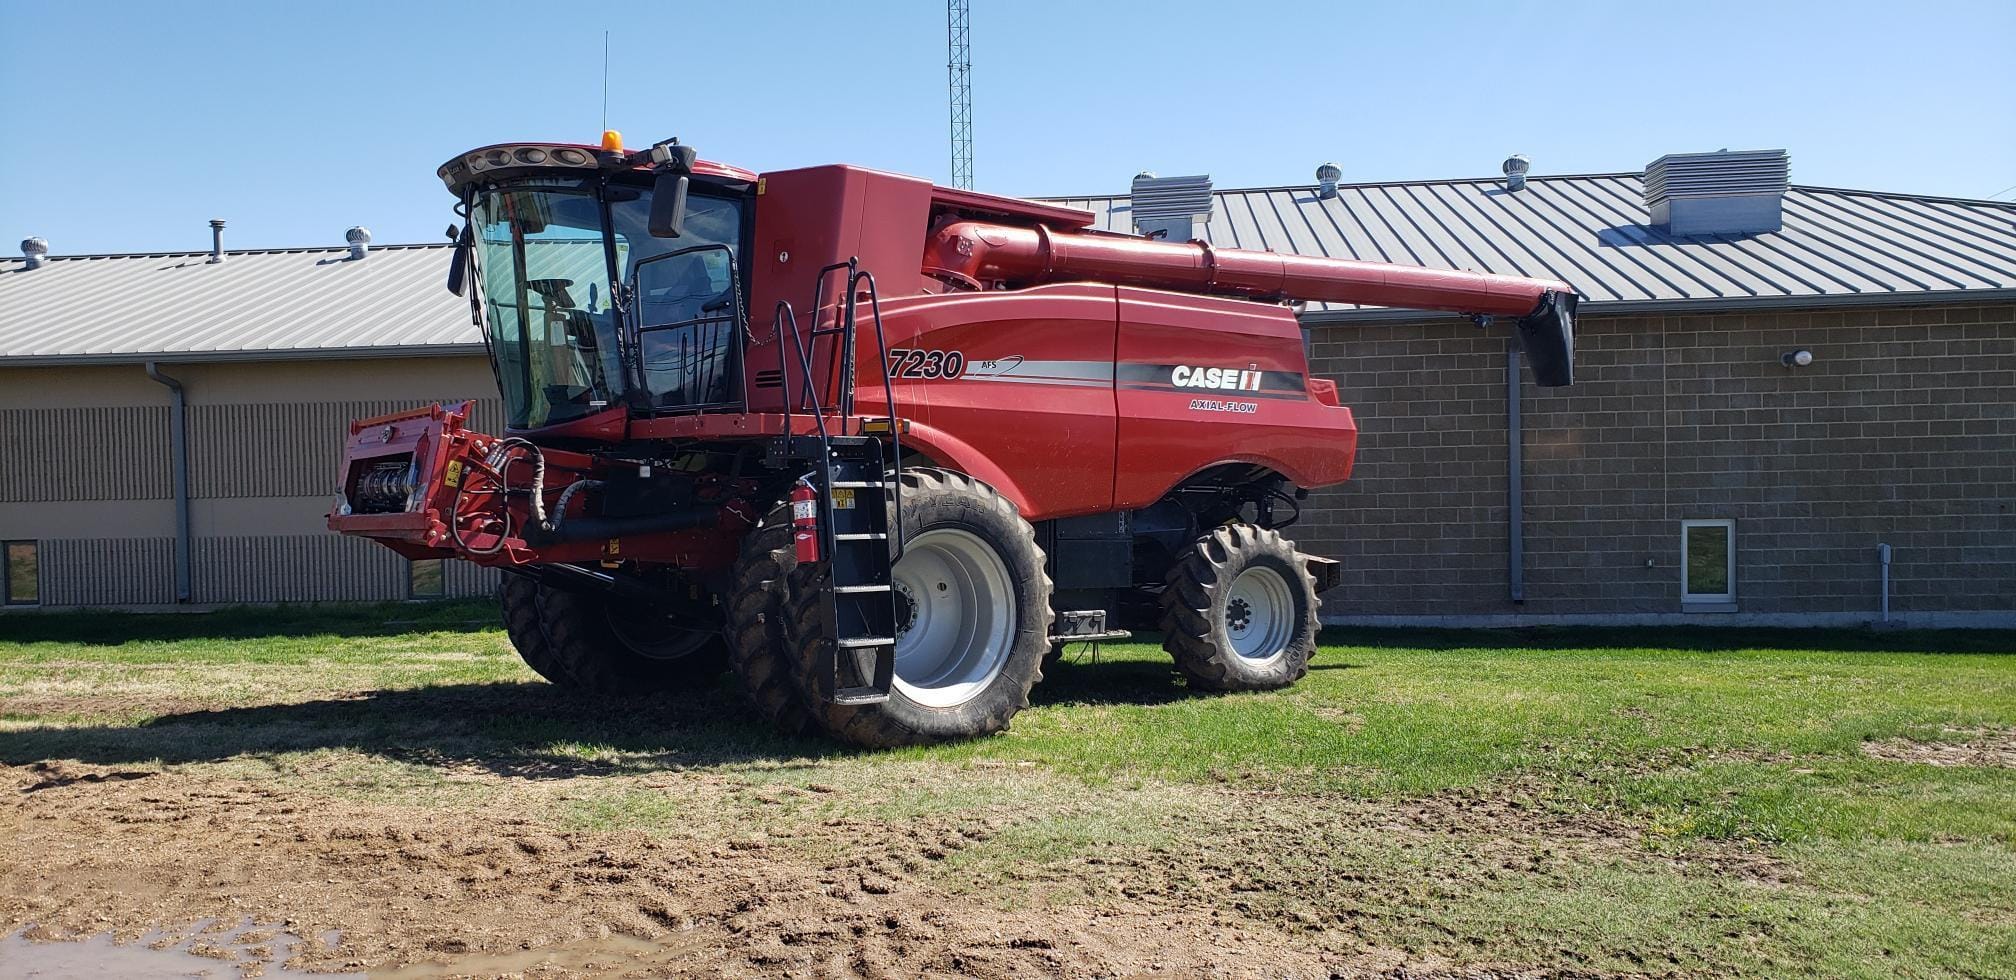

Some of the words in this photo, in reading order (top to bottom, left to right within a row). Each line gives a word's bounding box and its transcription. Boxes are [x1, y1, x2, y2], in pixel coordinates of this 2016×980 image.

[889, 349, 963, 380] 7230
[981, 360, 997, 369] AFS
[1171, 365, 1239, 390] CASE
[1189, 399, 1258, 413] AXIAL-FLOW
